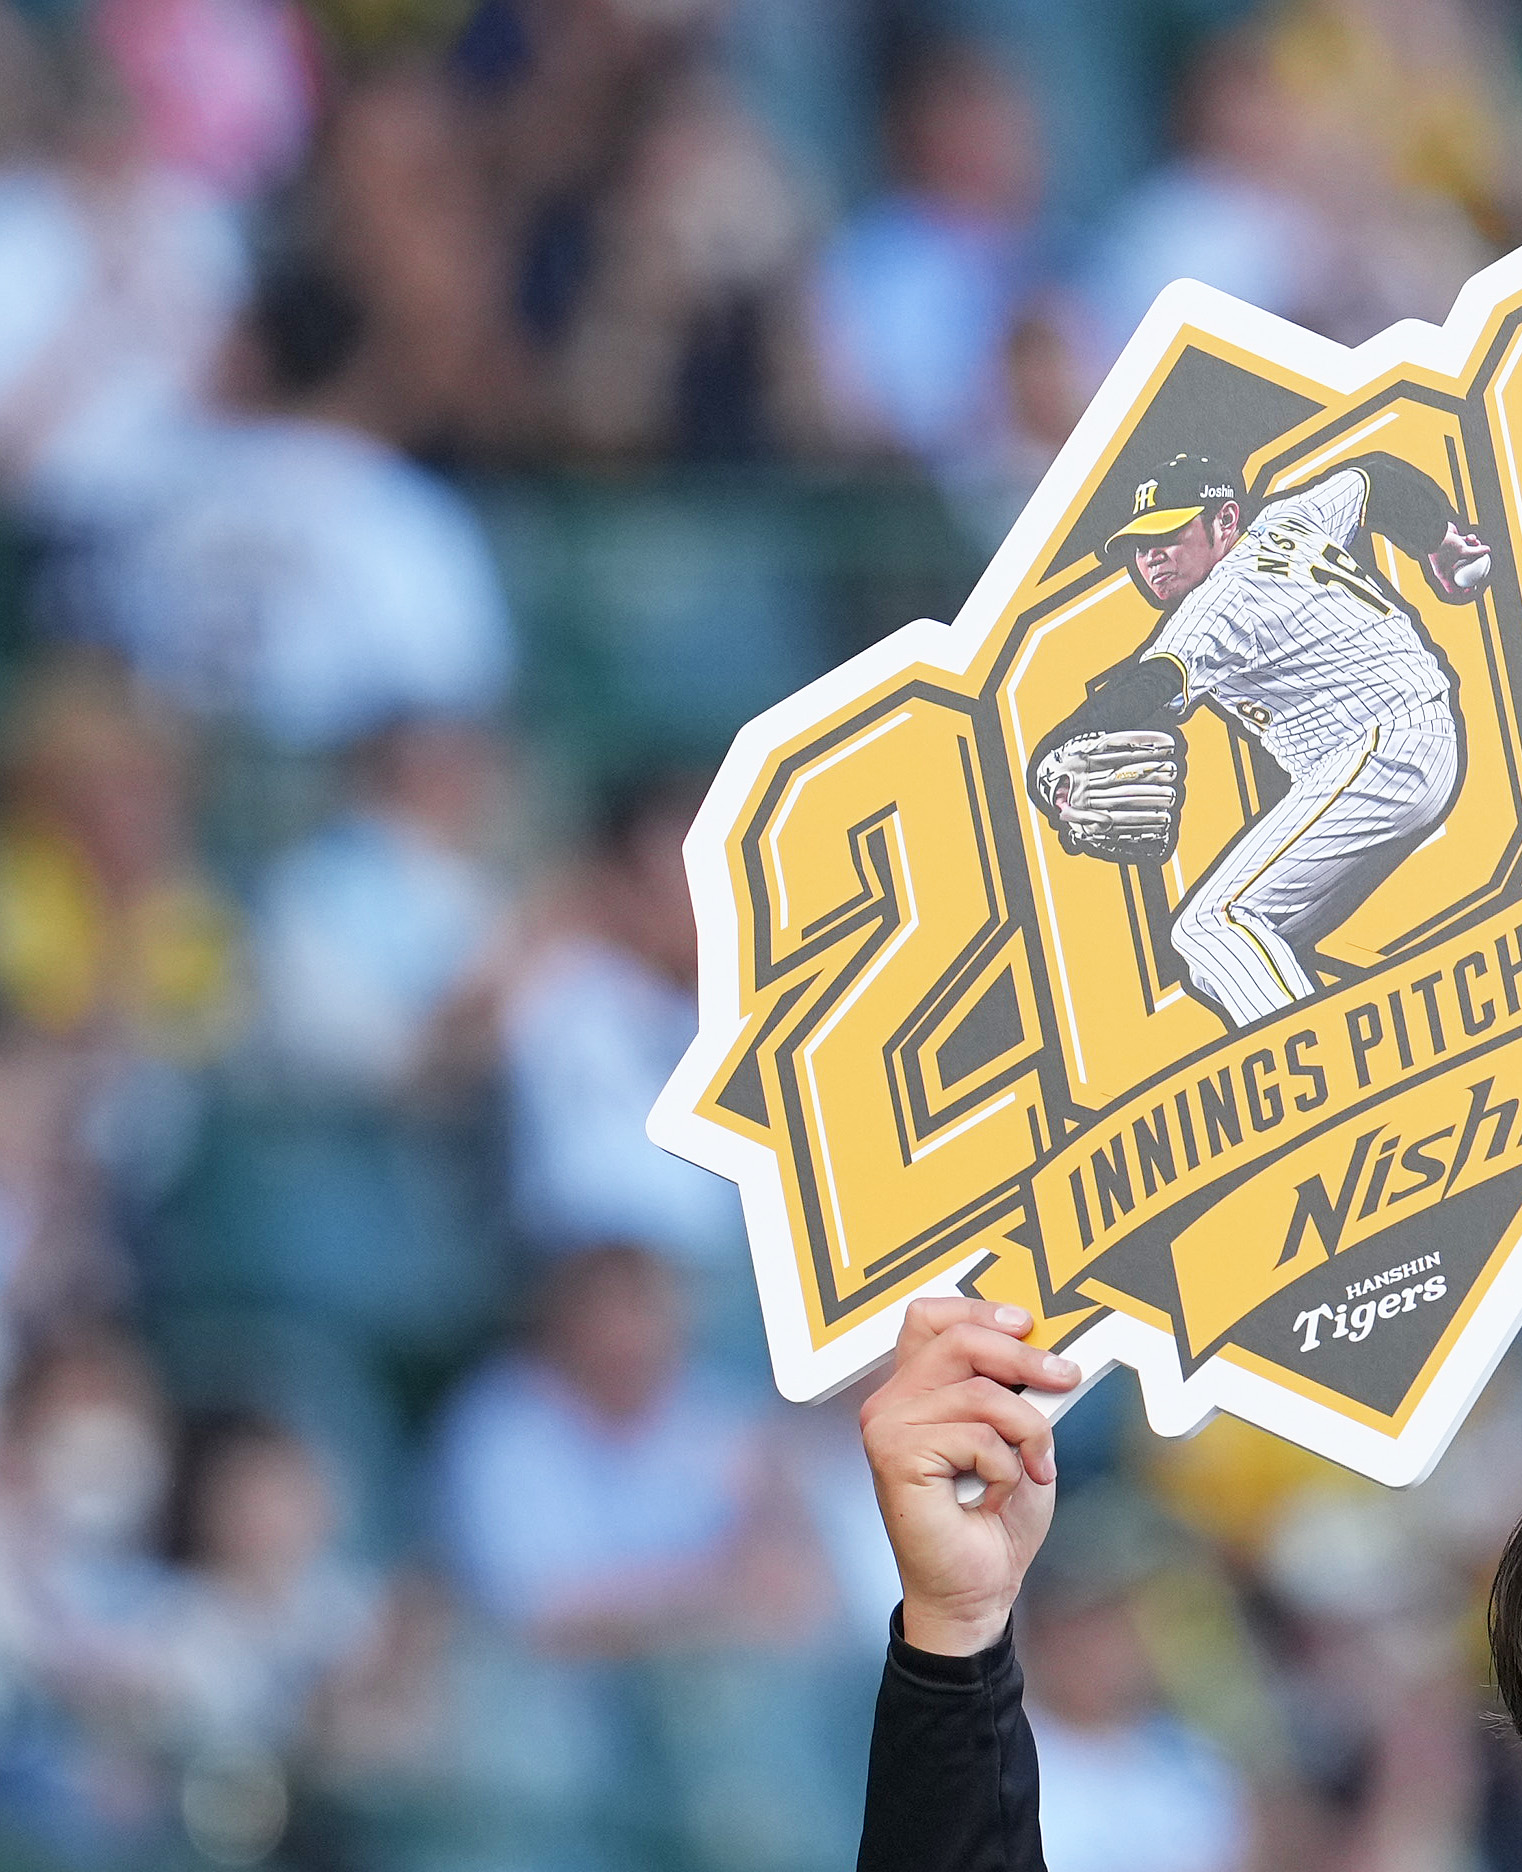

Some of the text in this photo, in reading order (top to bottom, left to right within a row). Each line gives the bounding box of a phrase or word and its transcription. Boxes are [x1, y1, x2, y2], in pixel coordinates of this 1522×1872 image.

[1200, 484, 1234, 498] Joshin
[1068, 1029, 1329, 1252] INNINGS
[1346, 1251, 1441, 1300] HANSHIN
[1293, 1275, 1447, 1352] Tigers
